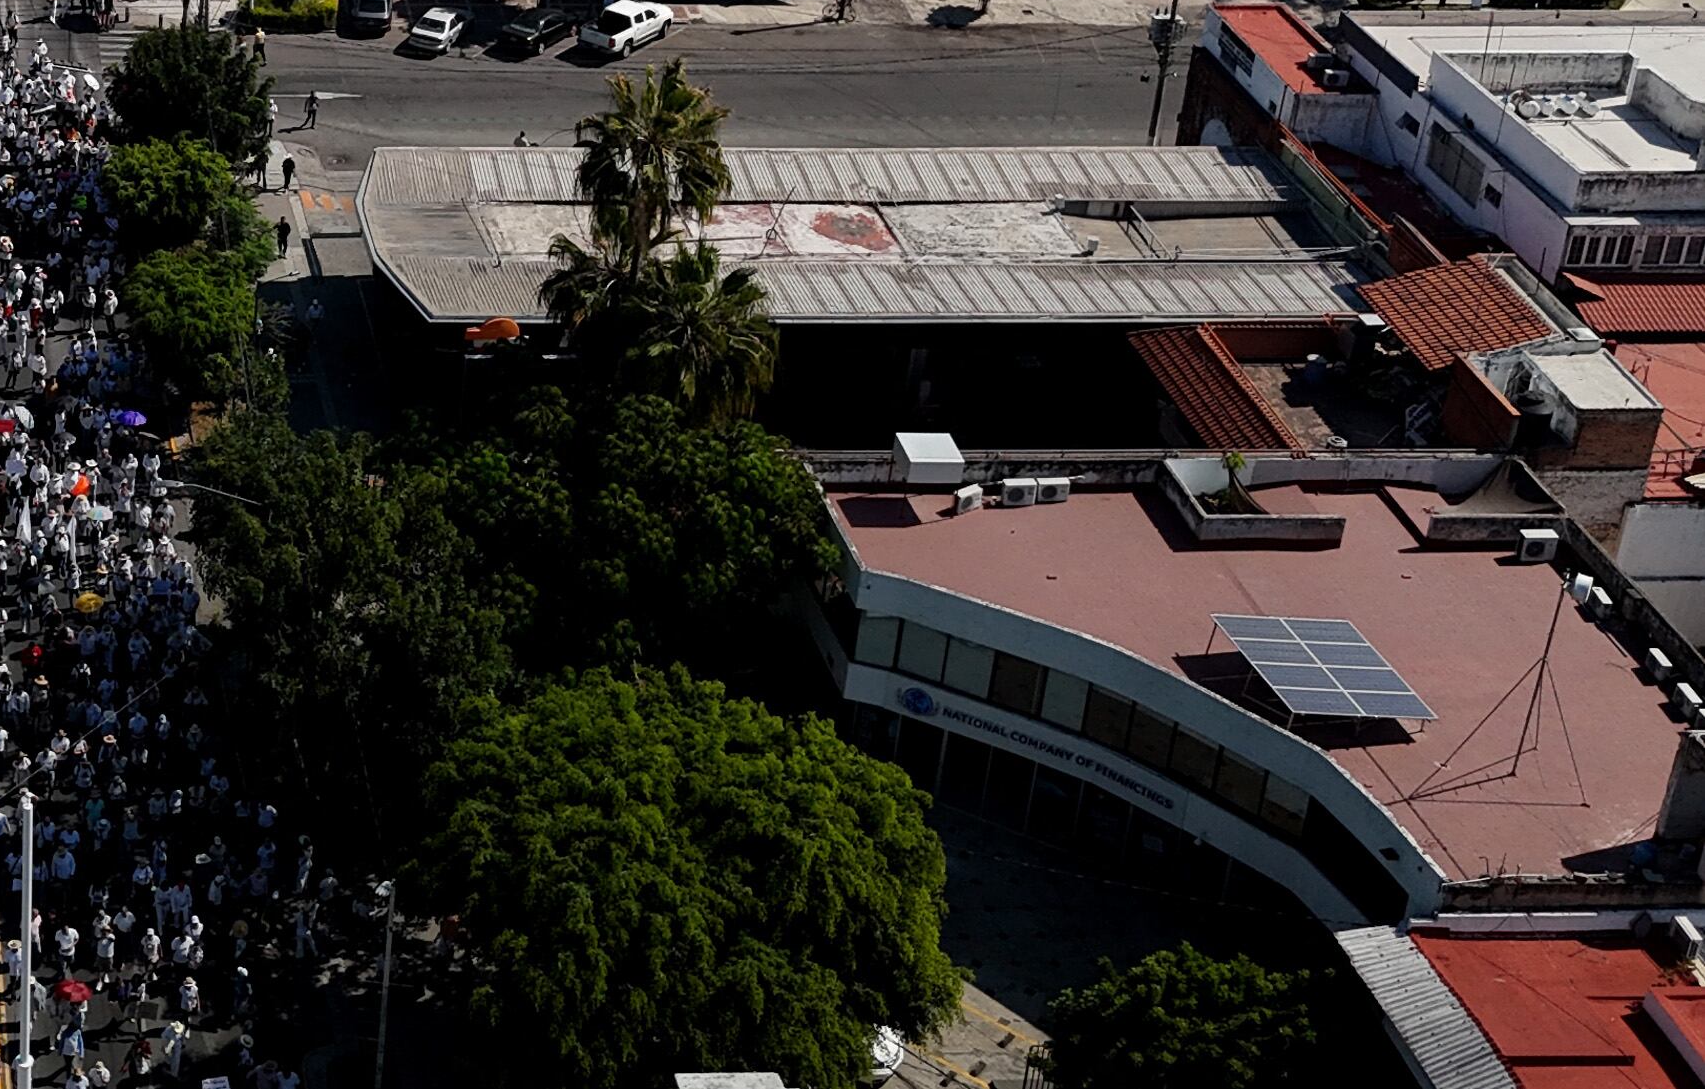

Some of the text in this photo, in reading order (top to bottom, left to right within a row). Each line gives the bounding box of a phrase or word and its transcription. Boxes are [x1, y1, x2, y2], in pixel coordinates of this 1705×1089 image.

[944, 709, 1174, 810] NATIONAL COMPANY OF FINANCINGS
